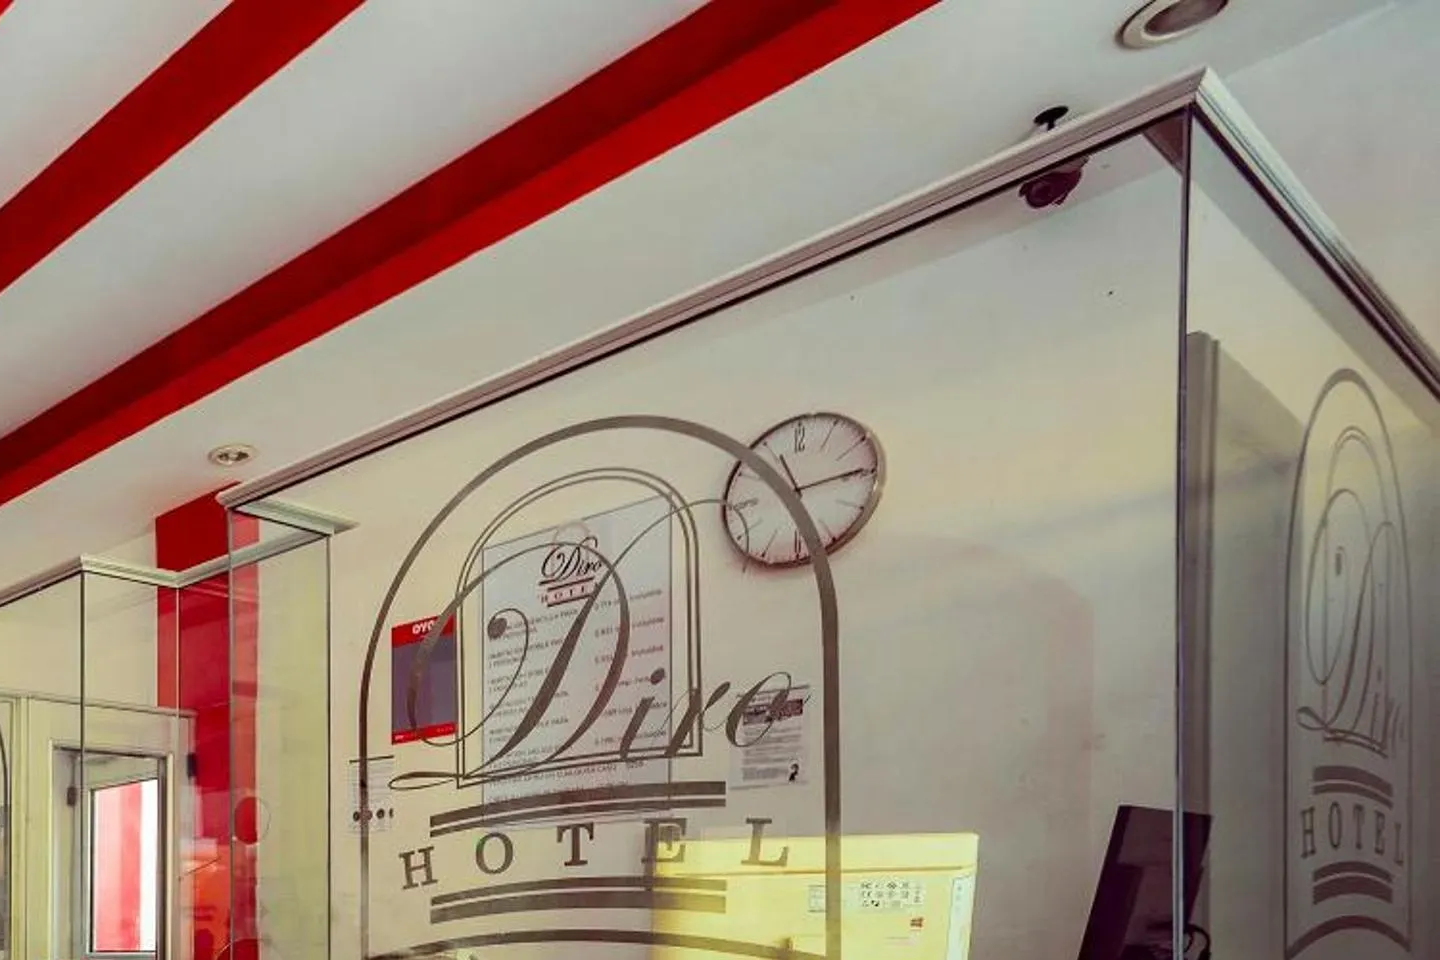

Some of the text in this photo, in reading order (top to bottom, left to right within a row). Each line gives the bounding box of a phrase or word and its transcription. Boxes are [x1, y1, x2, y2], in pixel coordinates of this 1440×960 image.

[389, 499, 810, 789] Diro
[399, 817, 789, 889] HOTEL
[1300, 801, 1404, 867] HOTEL
